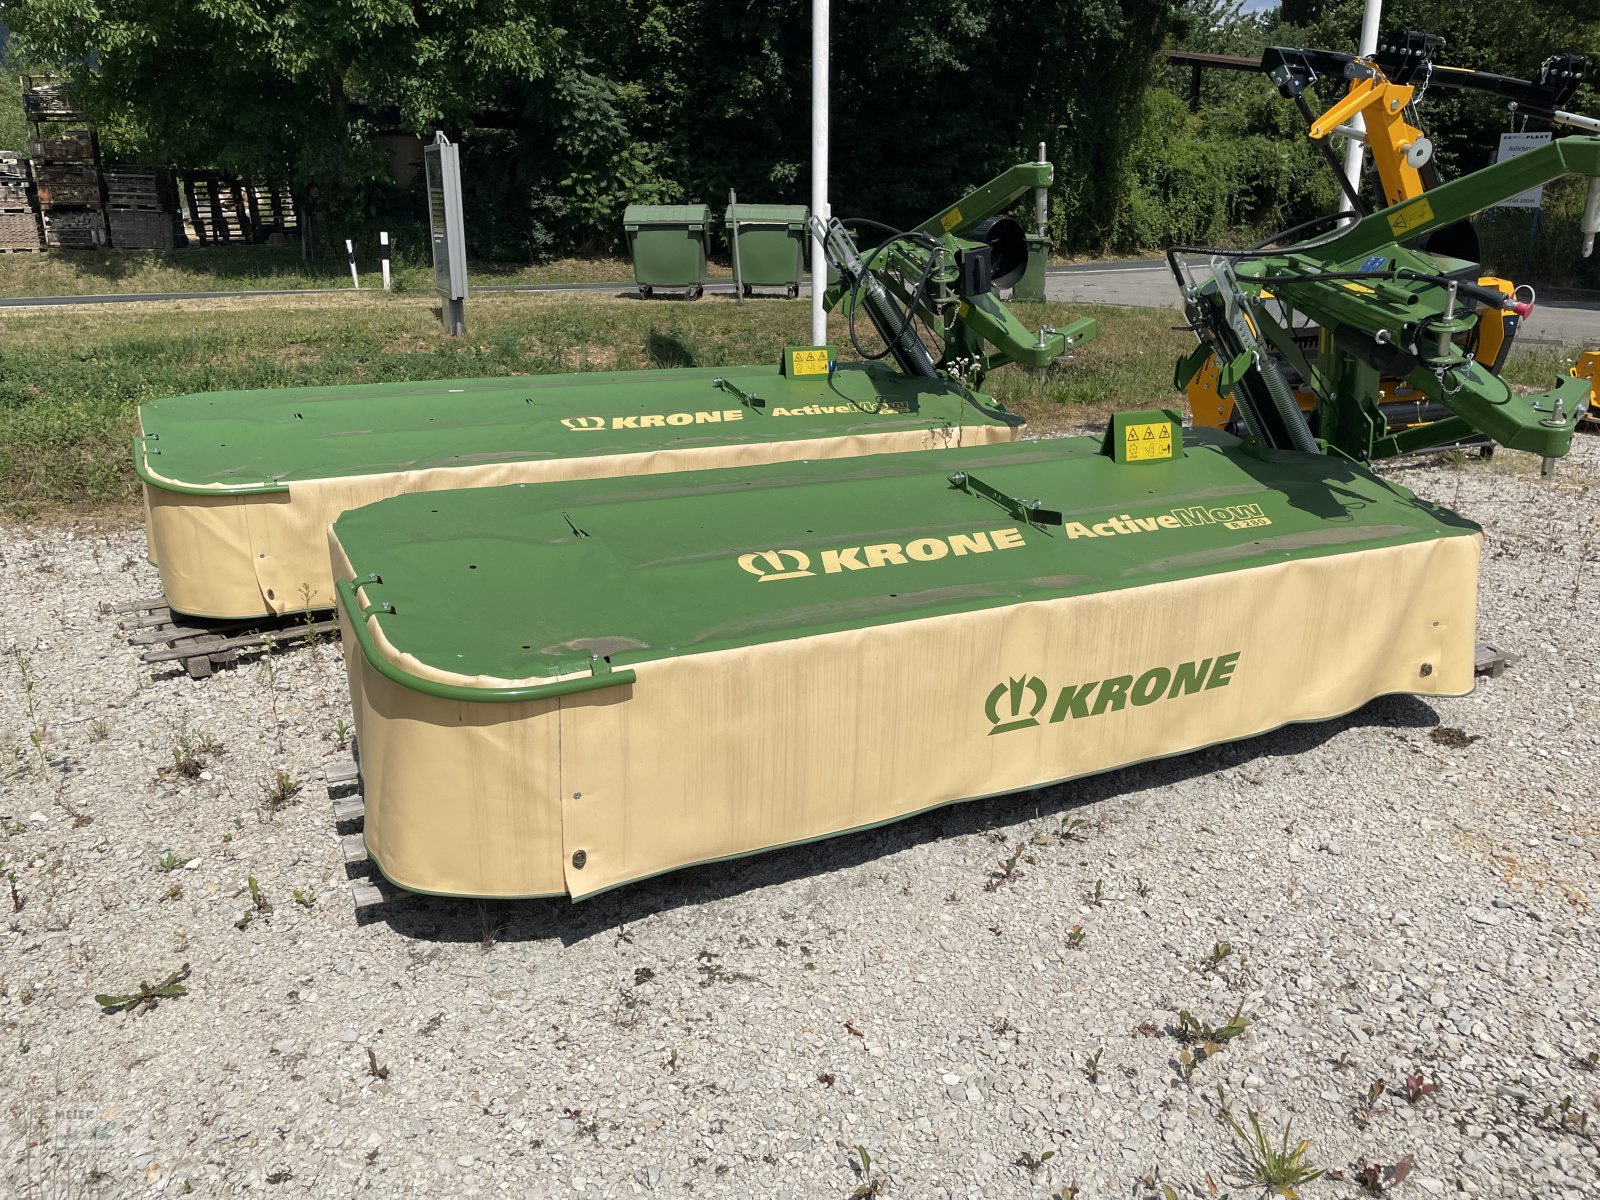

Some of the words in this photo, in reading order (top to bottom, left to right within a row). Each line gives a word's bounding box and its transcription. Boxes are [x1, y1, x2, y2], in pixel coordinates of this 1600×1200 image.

[612, 409, 743, 430] KRONE
[821, 527, 1026, 574] KRONE
[1065, 503, 1265, 539] ActiveMow
[1244, 519, 1266, 528] 280
[1048, 651, 1241, 725] KRONE
